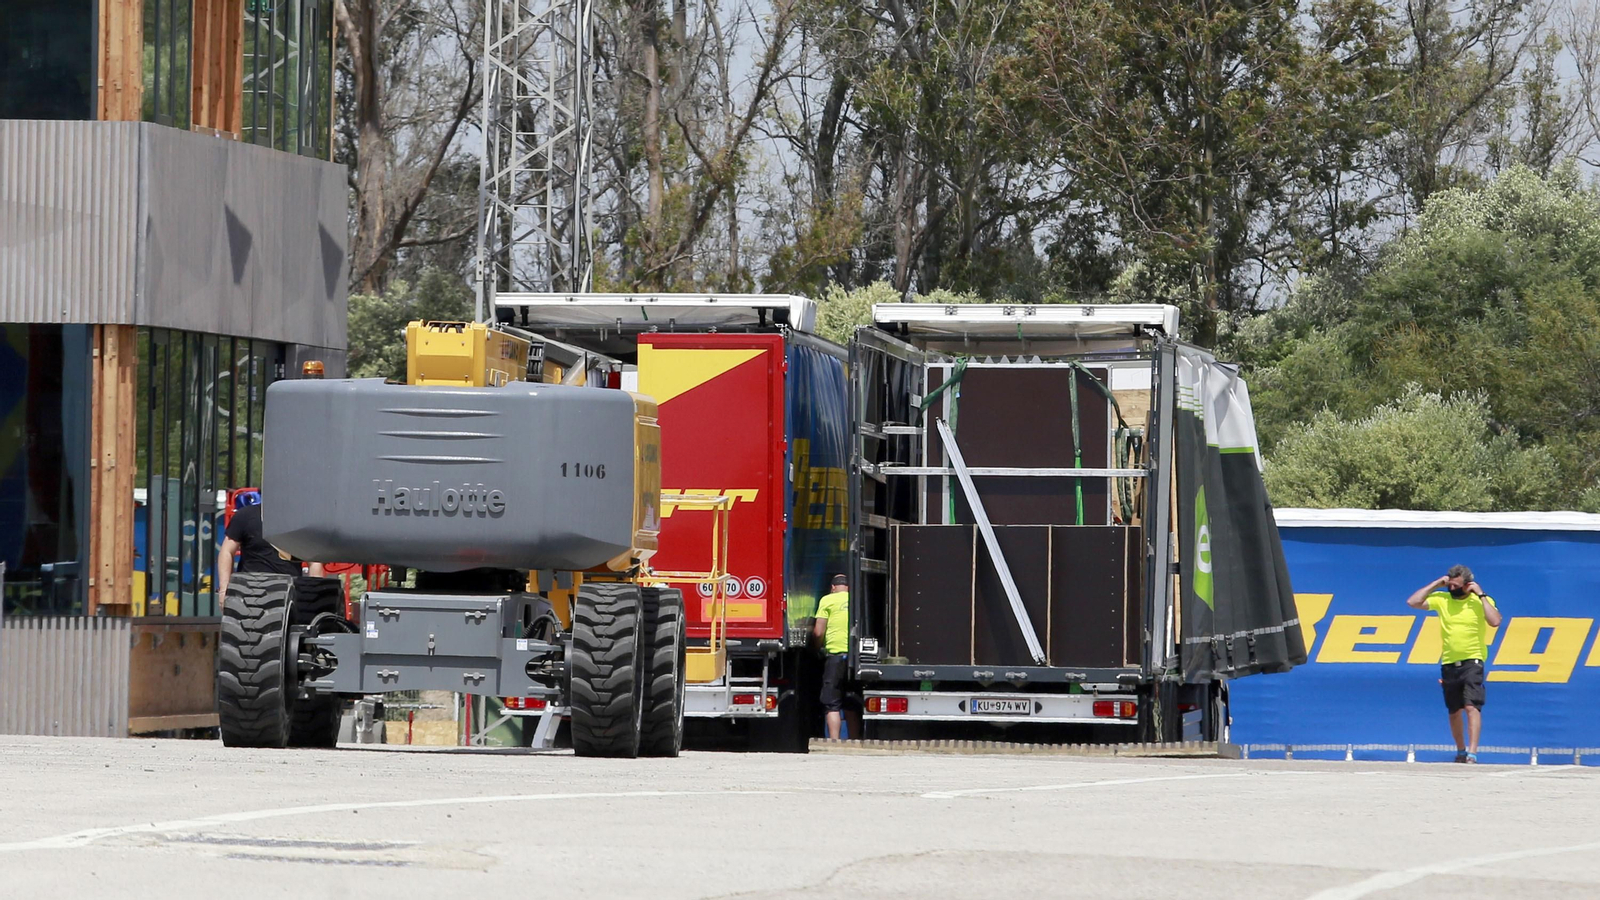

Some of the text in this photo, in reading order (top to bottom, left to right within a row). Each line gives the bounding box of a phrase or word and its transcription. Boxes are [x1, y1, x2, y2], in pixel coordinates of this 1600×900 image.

[560, 462, 606, 480] 1106
[372, 479, 506, 518] Haulotte
[702, 583, 713, 592] 60
[726, 583, 737, 592] 70
[749, 583, 760, 592] 80
